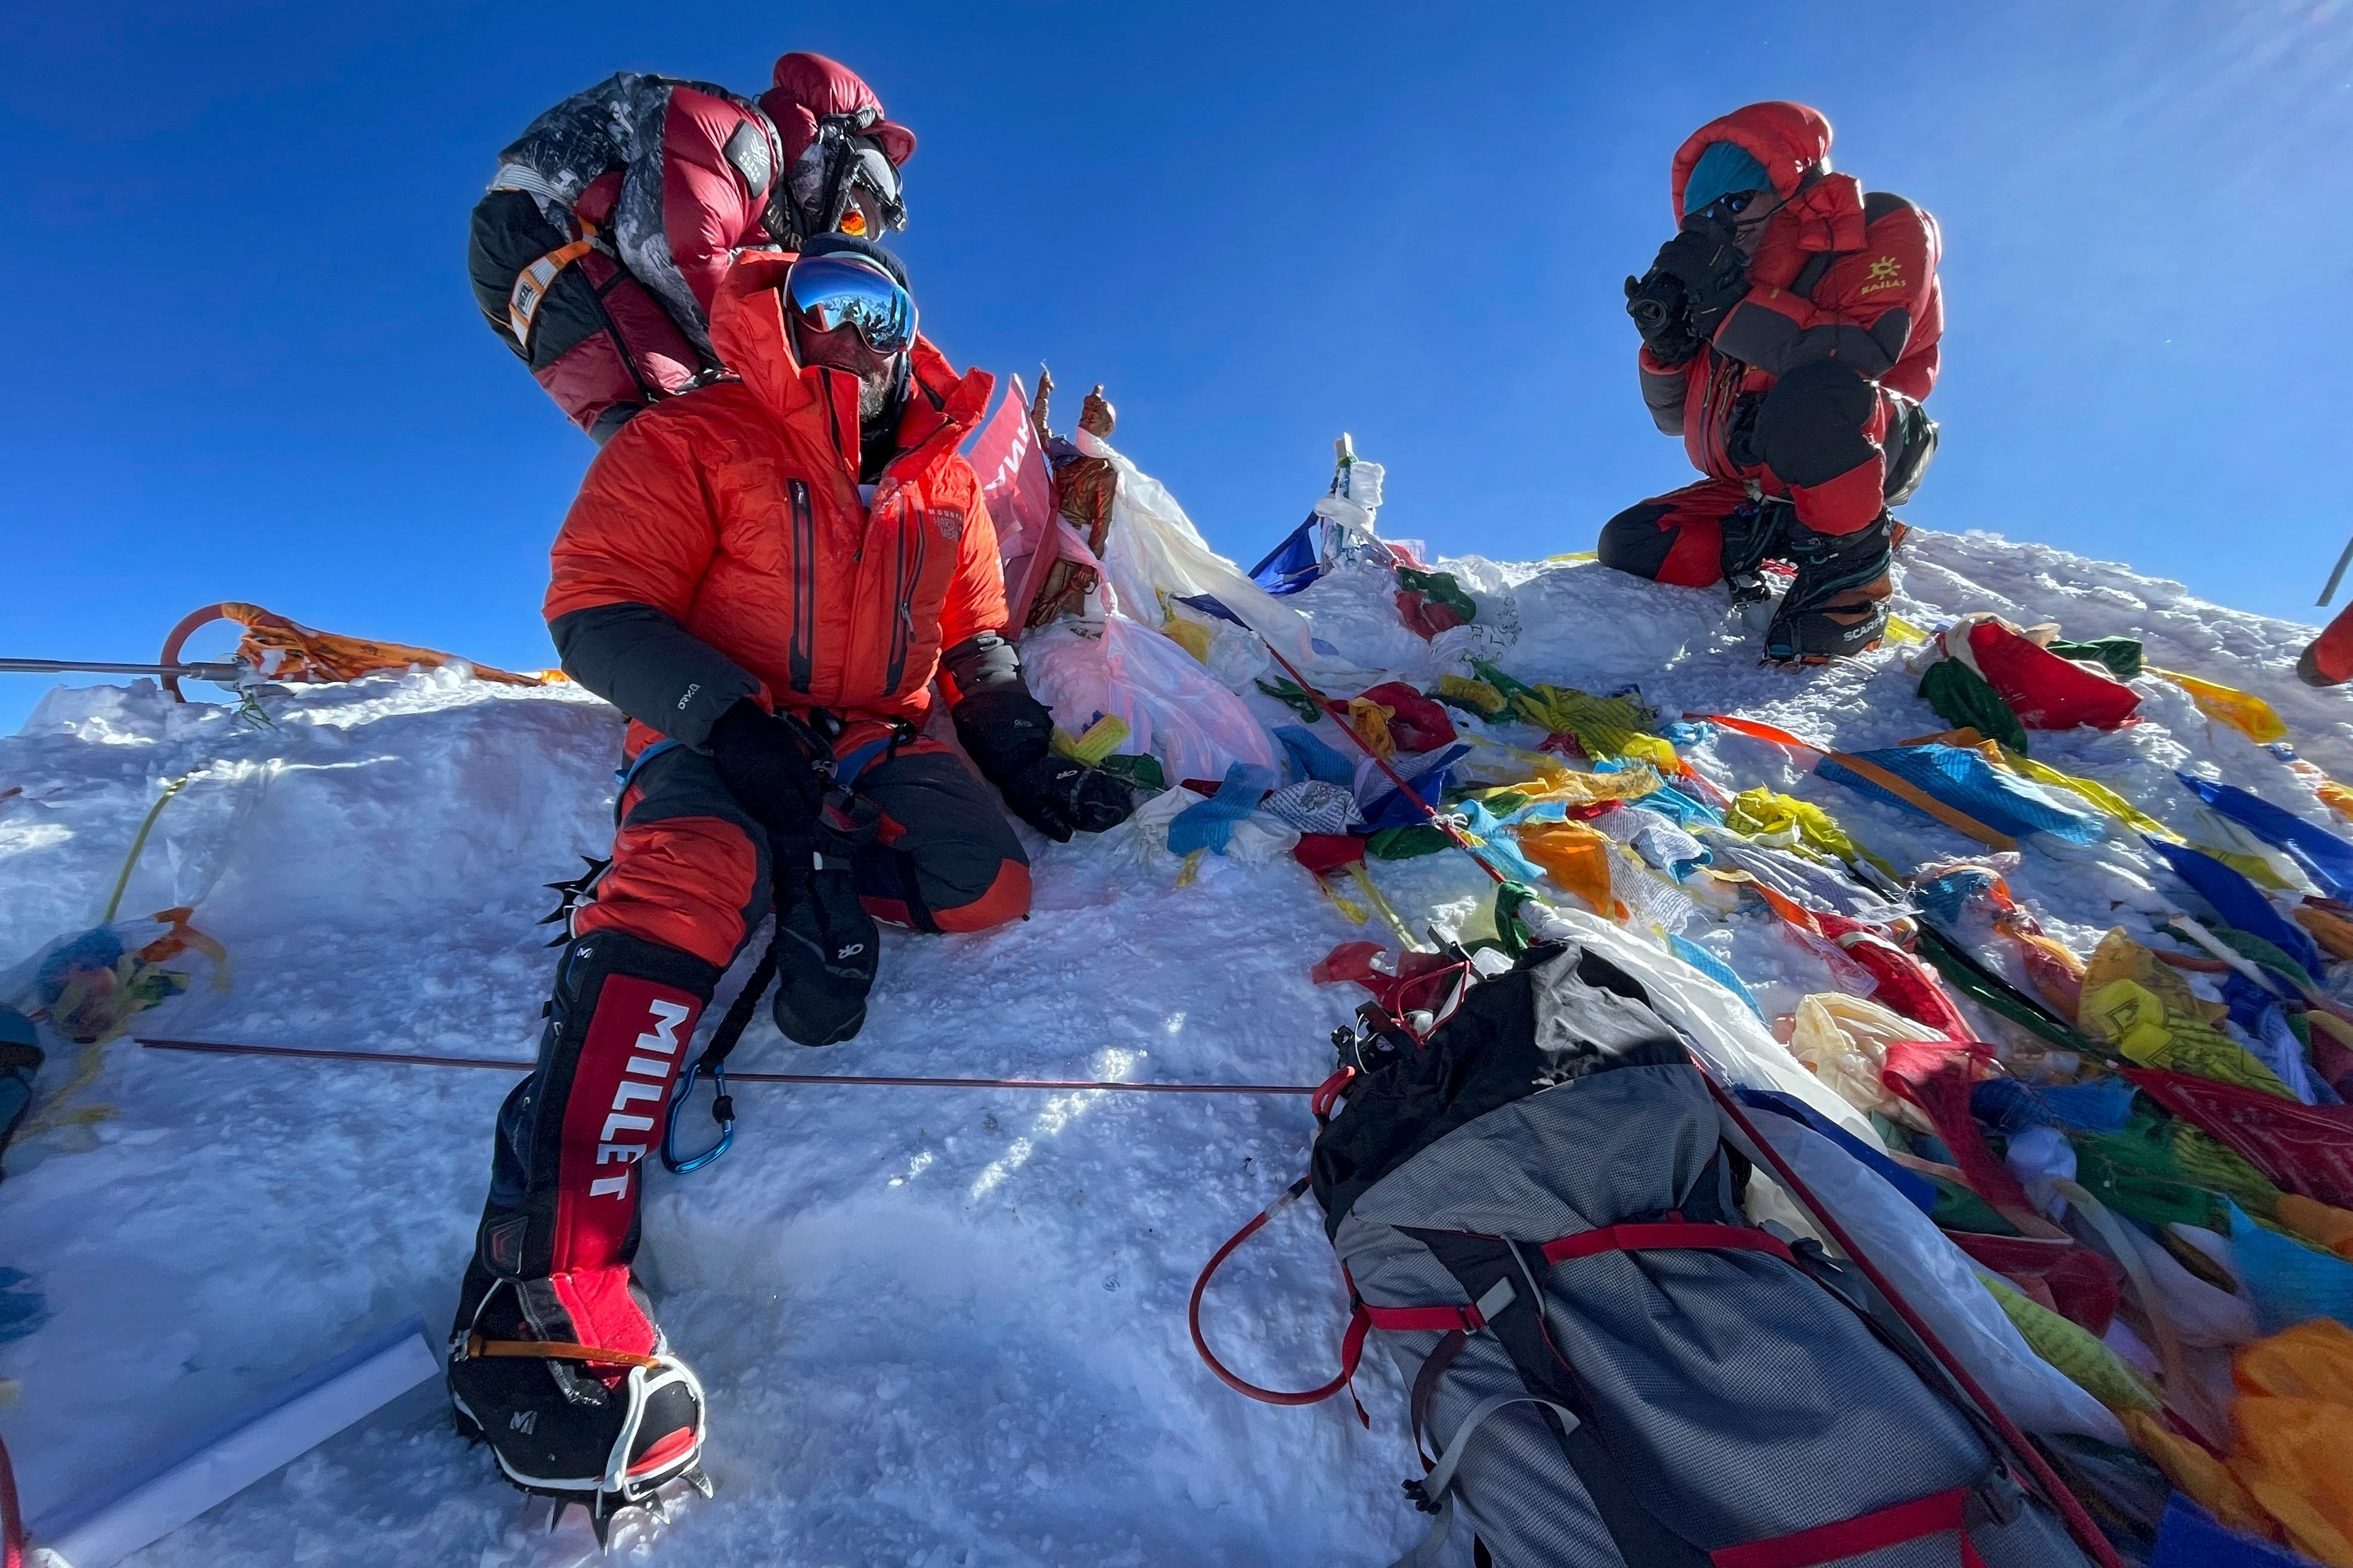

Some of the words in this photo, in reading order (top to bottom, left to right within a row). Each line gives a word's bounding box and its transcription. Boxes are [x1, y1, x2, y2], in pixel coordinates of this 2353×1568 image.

[742, 150, 761, 178] ELITE
[1861, 280, 1906, 295] KAILAS
[589, 999, 690, 1201] MILLET
